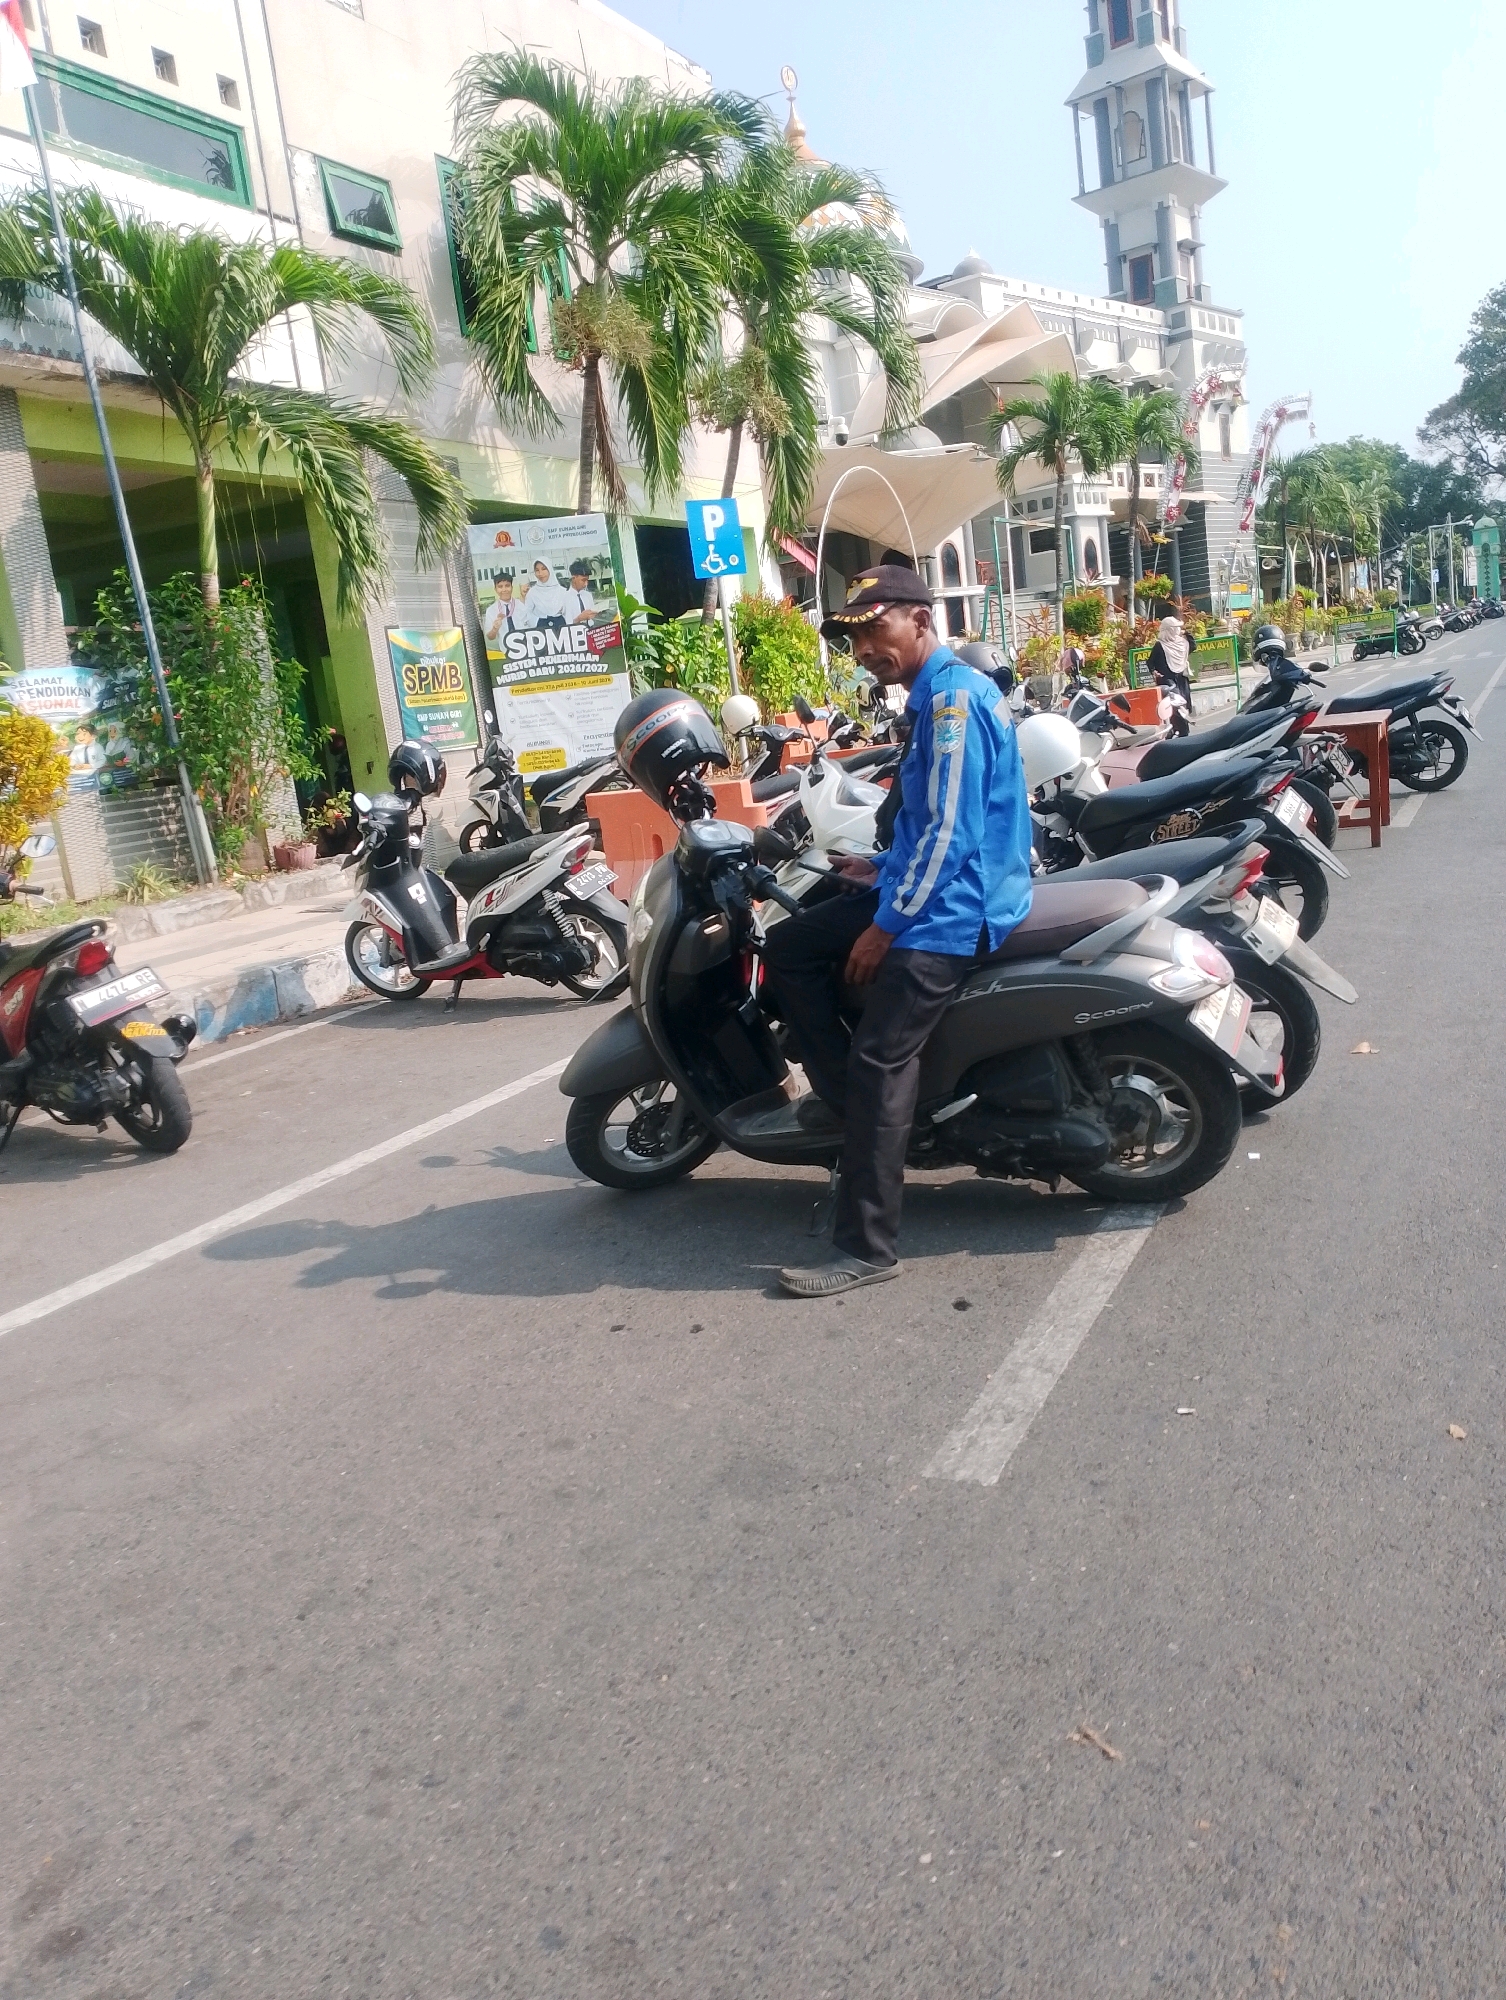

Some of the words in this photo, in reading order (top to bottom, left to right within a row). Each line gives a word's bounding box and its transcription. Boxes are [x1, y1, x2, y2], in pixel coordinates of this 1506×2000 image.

[702, 505, 724, 542] P
[505, 624, 588, 660] SPMB
[496, 670, 528, 686] MURID
[528, 666, 555, 678] BARU
[558, 664, 608, 674] 2026/2027
[503, 658, 537, 674] SISTEM
[10, 676, 63, 690] SELAMAT
[404, 664, 462, 692] SPMB
[16, 686, 91, 700] PENDIDIKAN
[626, 705, 687, 751] SCOOPY
[1158, 820, 1198, 839] STREET
[1247, 932, 1262, 948] N
[1074, 1000, 1154, 1024] SCOOPY
